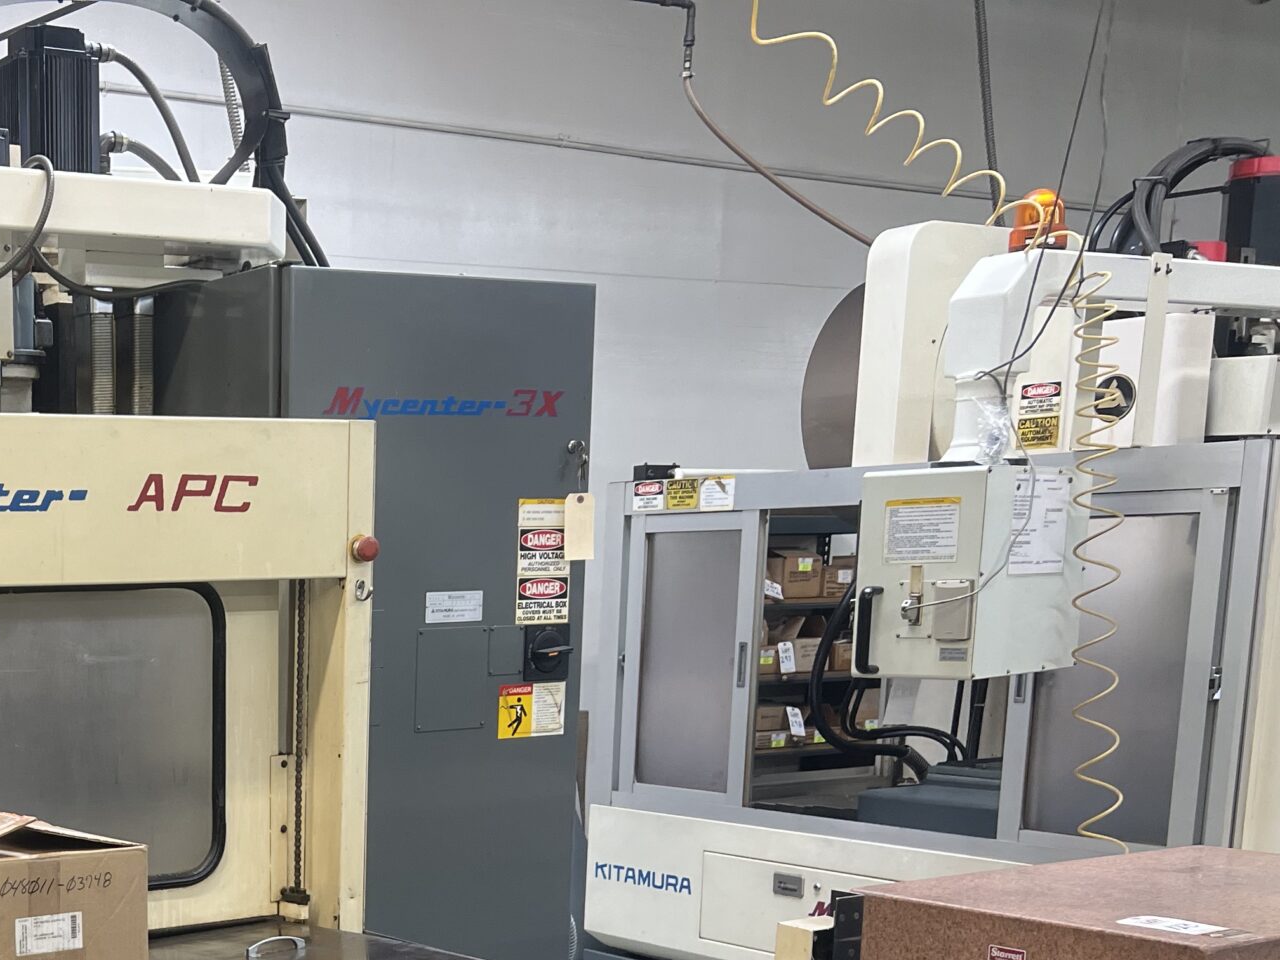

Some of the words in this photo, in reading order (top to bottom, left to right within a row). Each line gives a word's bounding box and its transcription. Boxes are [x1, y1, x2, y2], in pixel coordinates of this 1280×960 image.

[1027, 386, 1055, 395] DANGER
[322, 386, 566, 420] Mycenter-3X
[1019, 417, 1058, 429] CAUTION
[1021, 428, 1054, 436] AUTOMATIC
[126, 474, 259, 513] APC
[638, 484, 659, 493] DANGER
[527, 532, 563, 547] DANGER
[519, 551, 537, 560] HIGH
[538, 551, 565, 560] VOLTAG
[525, 582, 561, 596] DANGER
[517, 601, 554, 610] ELECTRICAL
[555, 600, 567, 608] BOX
[509, 686, 532, 694] DANGER
[594, 861, 692, 895] KITAMURA
